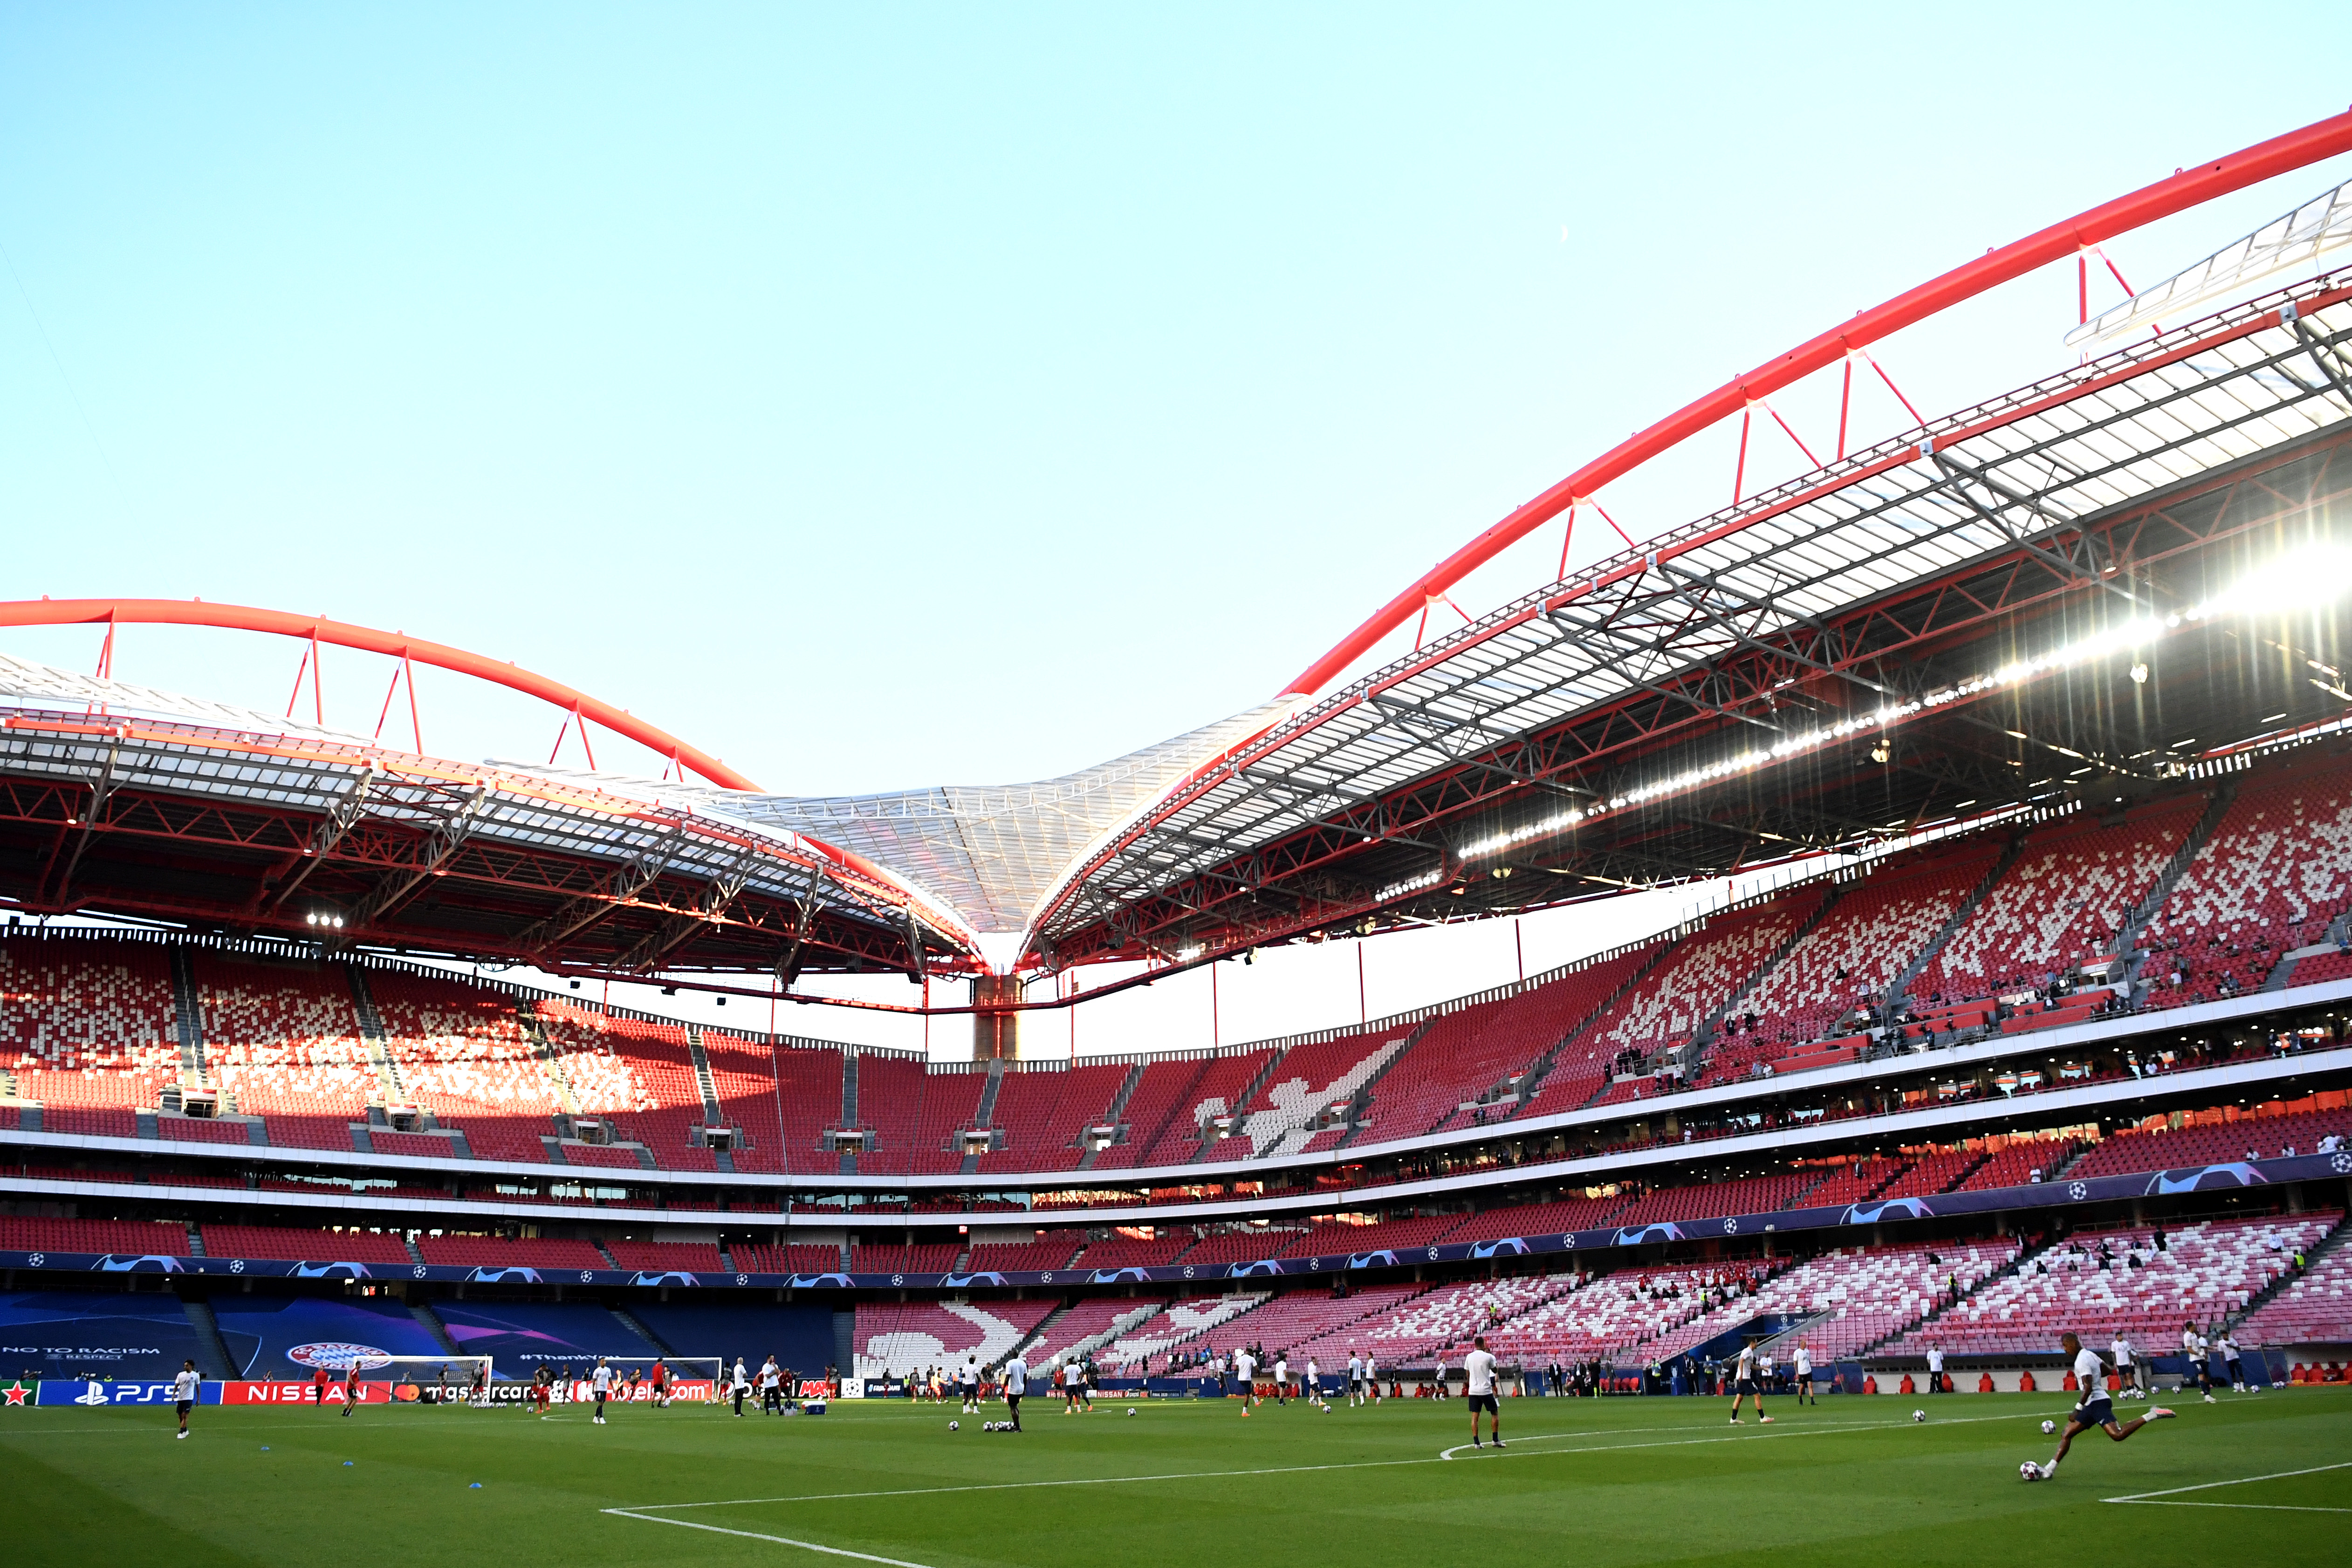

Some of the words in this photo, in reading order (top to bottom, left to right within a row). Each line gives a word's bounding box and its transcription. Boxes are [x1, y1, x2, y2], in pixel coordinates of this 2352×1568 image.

[116, 1385, 180, 1402] PS5
[248, 1385, 367, 1401] NISSAN
[798, 1380, 828, 1397] MAX
